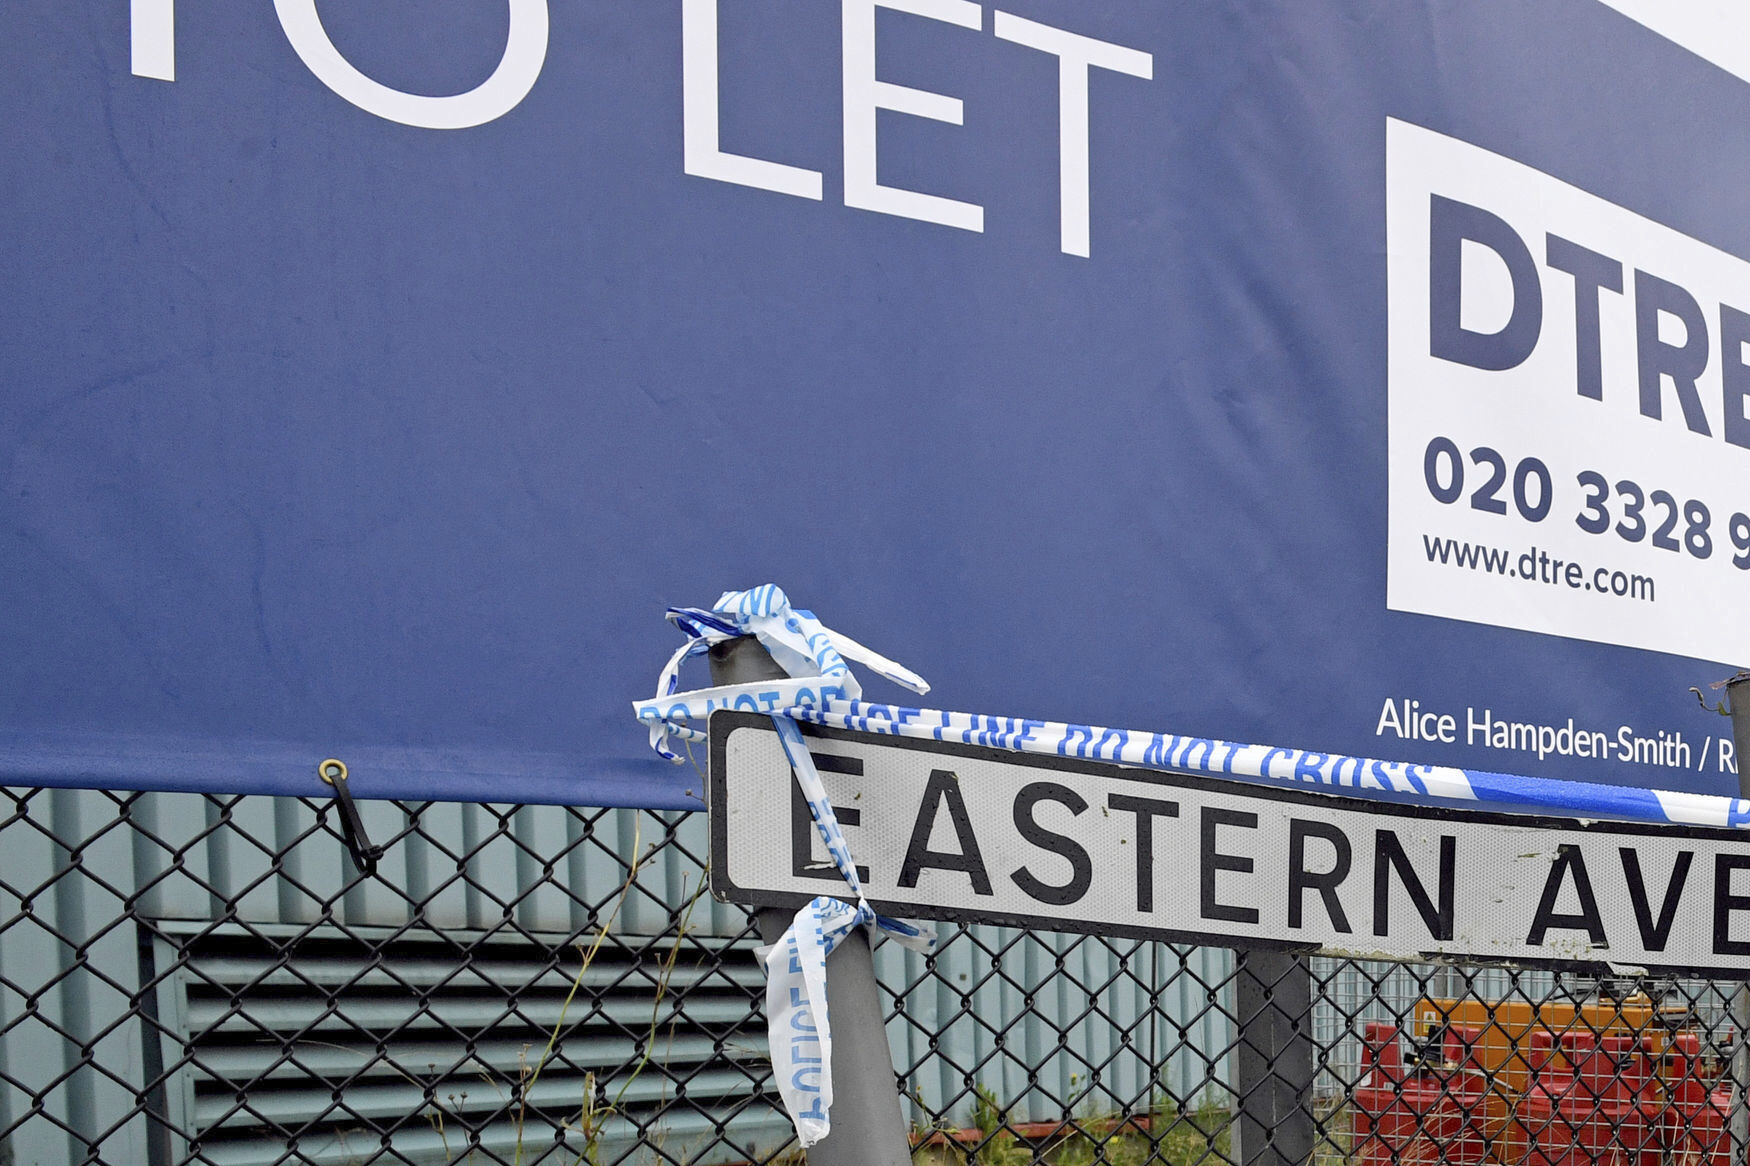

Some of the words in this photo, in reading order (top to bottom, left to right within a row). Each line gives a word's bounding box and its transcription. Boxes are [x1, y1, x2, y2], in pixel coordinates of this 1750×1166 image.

[683, 0, 1154, 258] LET
[1423, 435, 1553, 523] 020
[1574, 469, 1713, 560] 3328
[1422, 533, 1656, 602] www.dtre.com
[1143, 732, 1250, 773] NOT
[1375, 697, 1456, 744] Alice
[1466, 708, 1691, 770] Hampden-Smith
[790, 752, 1456, 942] EASTERN
